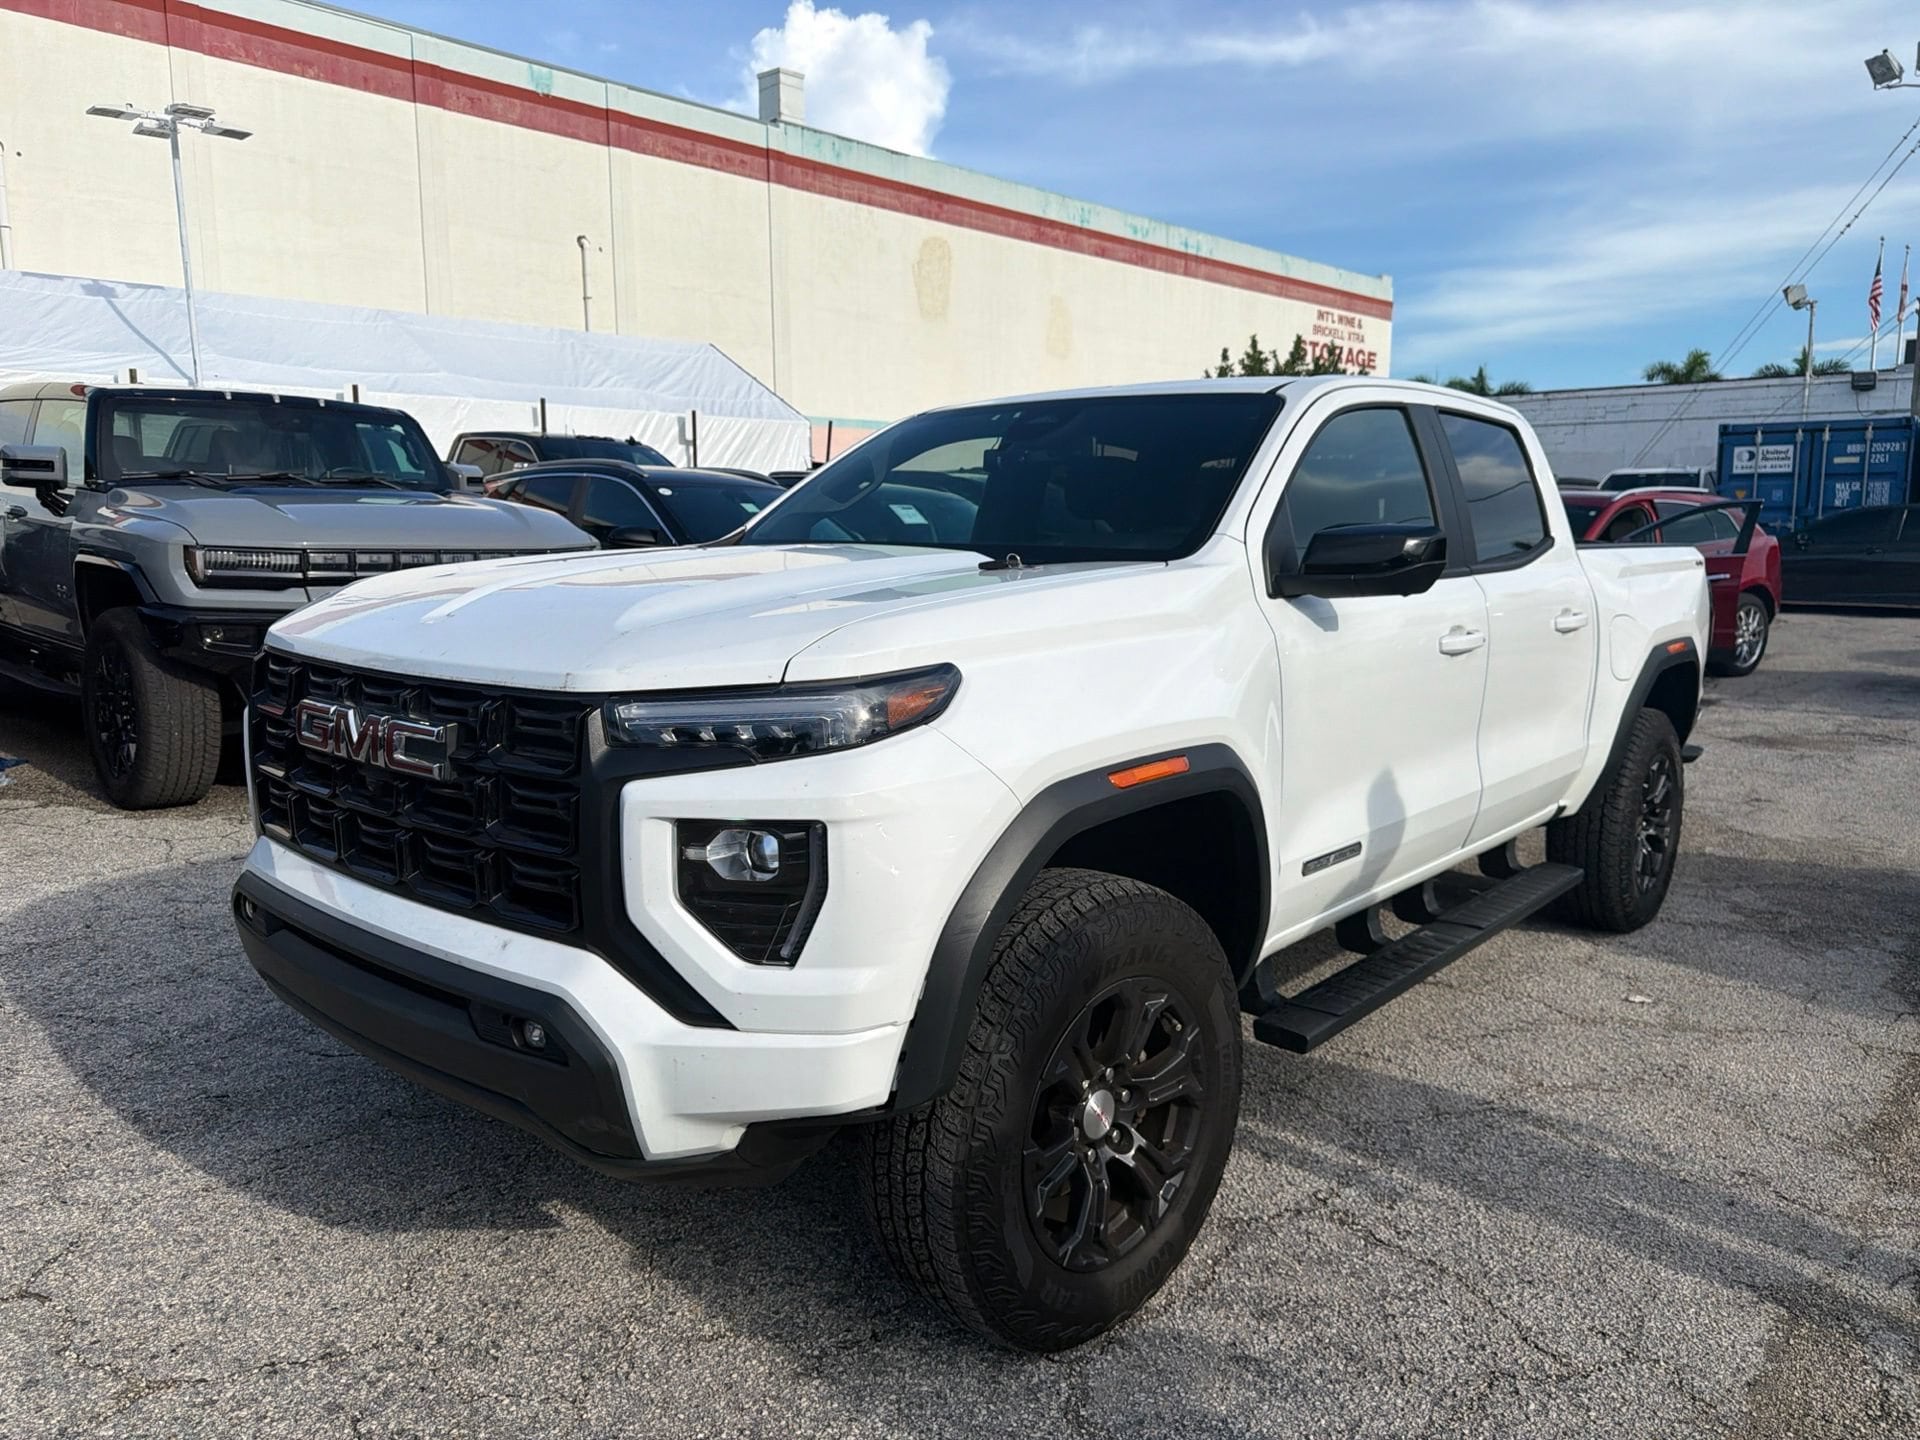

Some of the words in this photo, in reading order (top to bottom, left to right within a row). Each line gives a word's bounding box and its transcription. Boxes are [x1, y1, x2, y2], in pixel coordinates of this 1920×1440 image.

[1338, 314, 1355, 328] WINE
[1357, 318, 1363, 329] &
[1313, 324, 1344, 340] BRICKELL
[1348, 332, 1364, 343] XTRA
[1301, 339, 1377, 370] STORAGE
[1761, 448, 1789, 456] United
[295, 699, 455, 781] GMC
